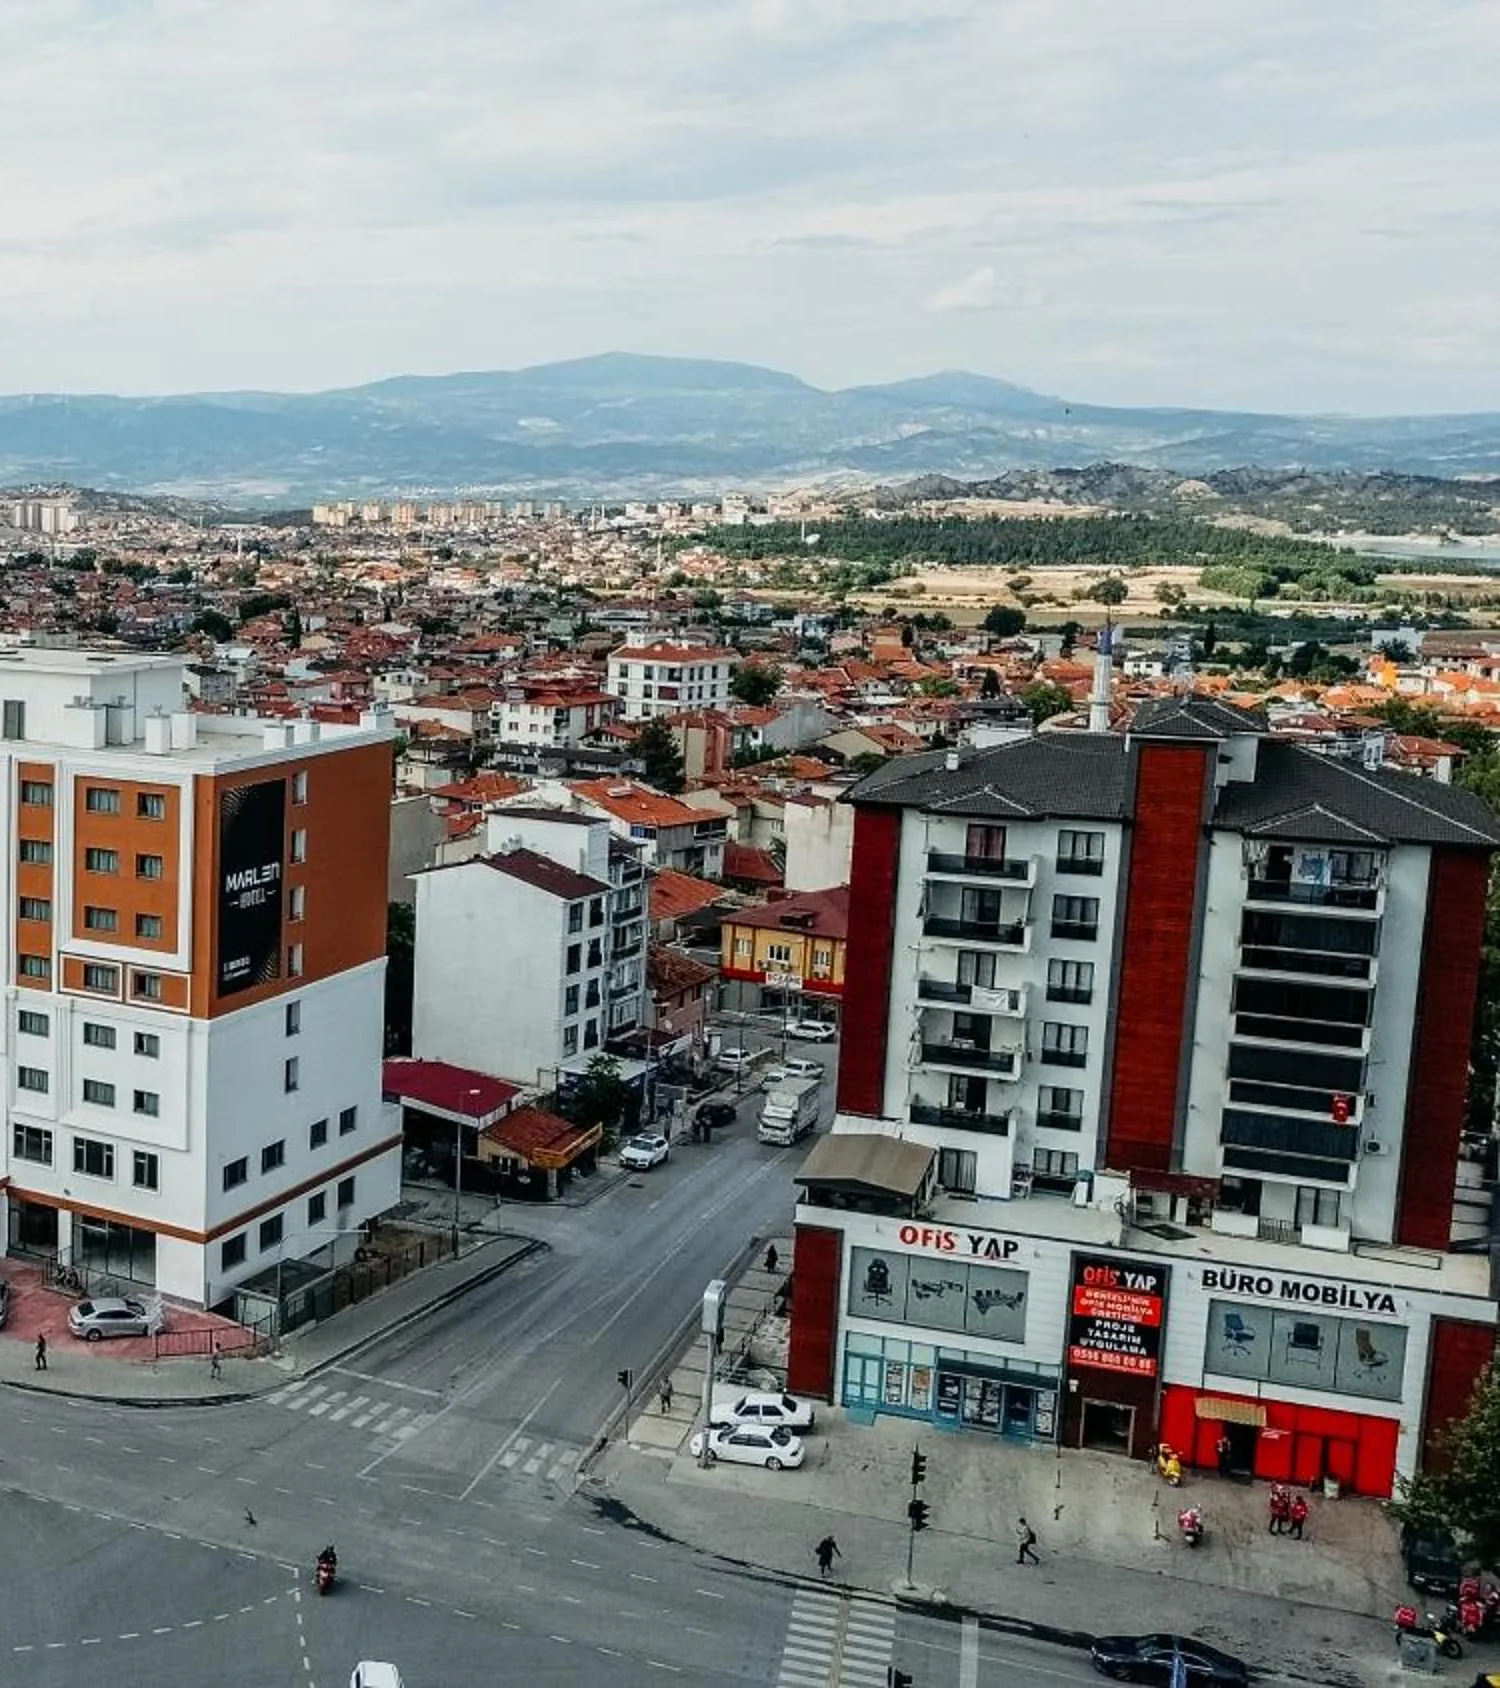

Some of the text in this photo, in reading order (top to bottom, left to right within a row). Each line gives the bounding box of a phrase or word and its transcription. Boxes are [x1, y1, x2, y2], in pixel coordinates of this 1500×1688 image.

[225, 861, 280, 893] MARLEN
[967, 1233, 1018, 1260] YAP
[1124, 1271, 1157, 1291] YAP
[1202, 1268, 1397, 1312] BÜRO MOBİLYA
[1095, 1319, 1135, 1333] PROJE
[1088, 1328, 1141, 1345] TASARIM
[1080, 1338, 1147, 1356] UYGULAMA
